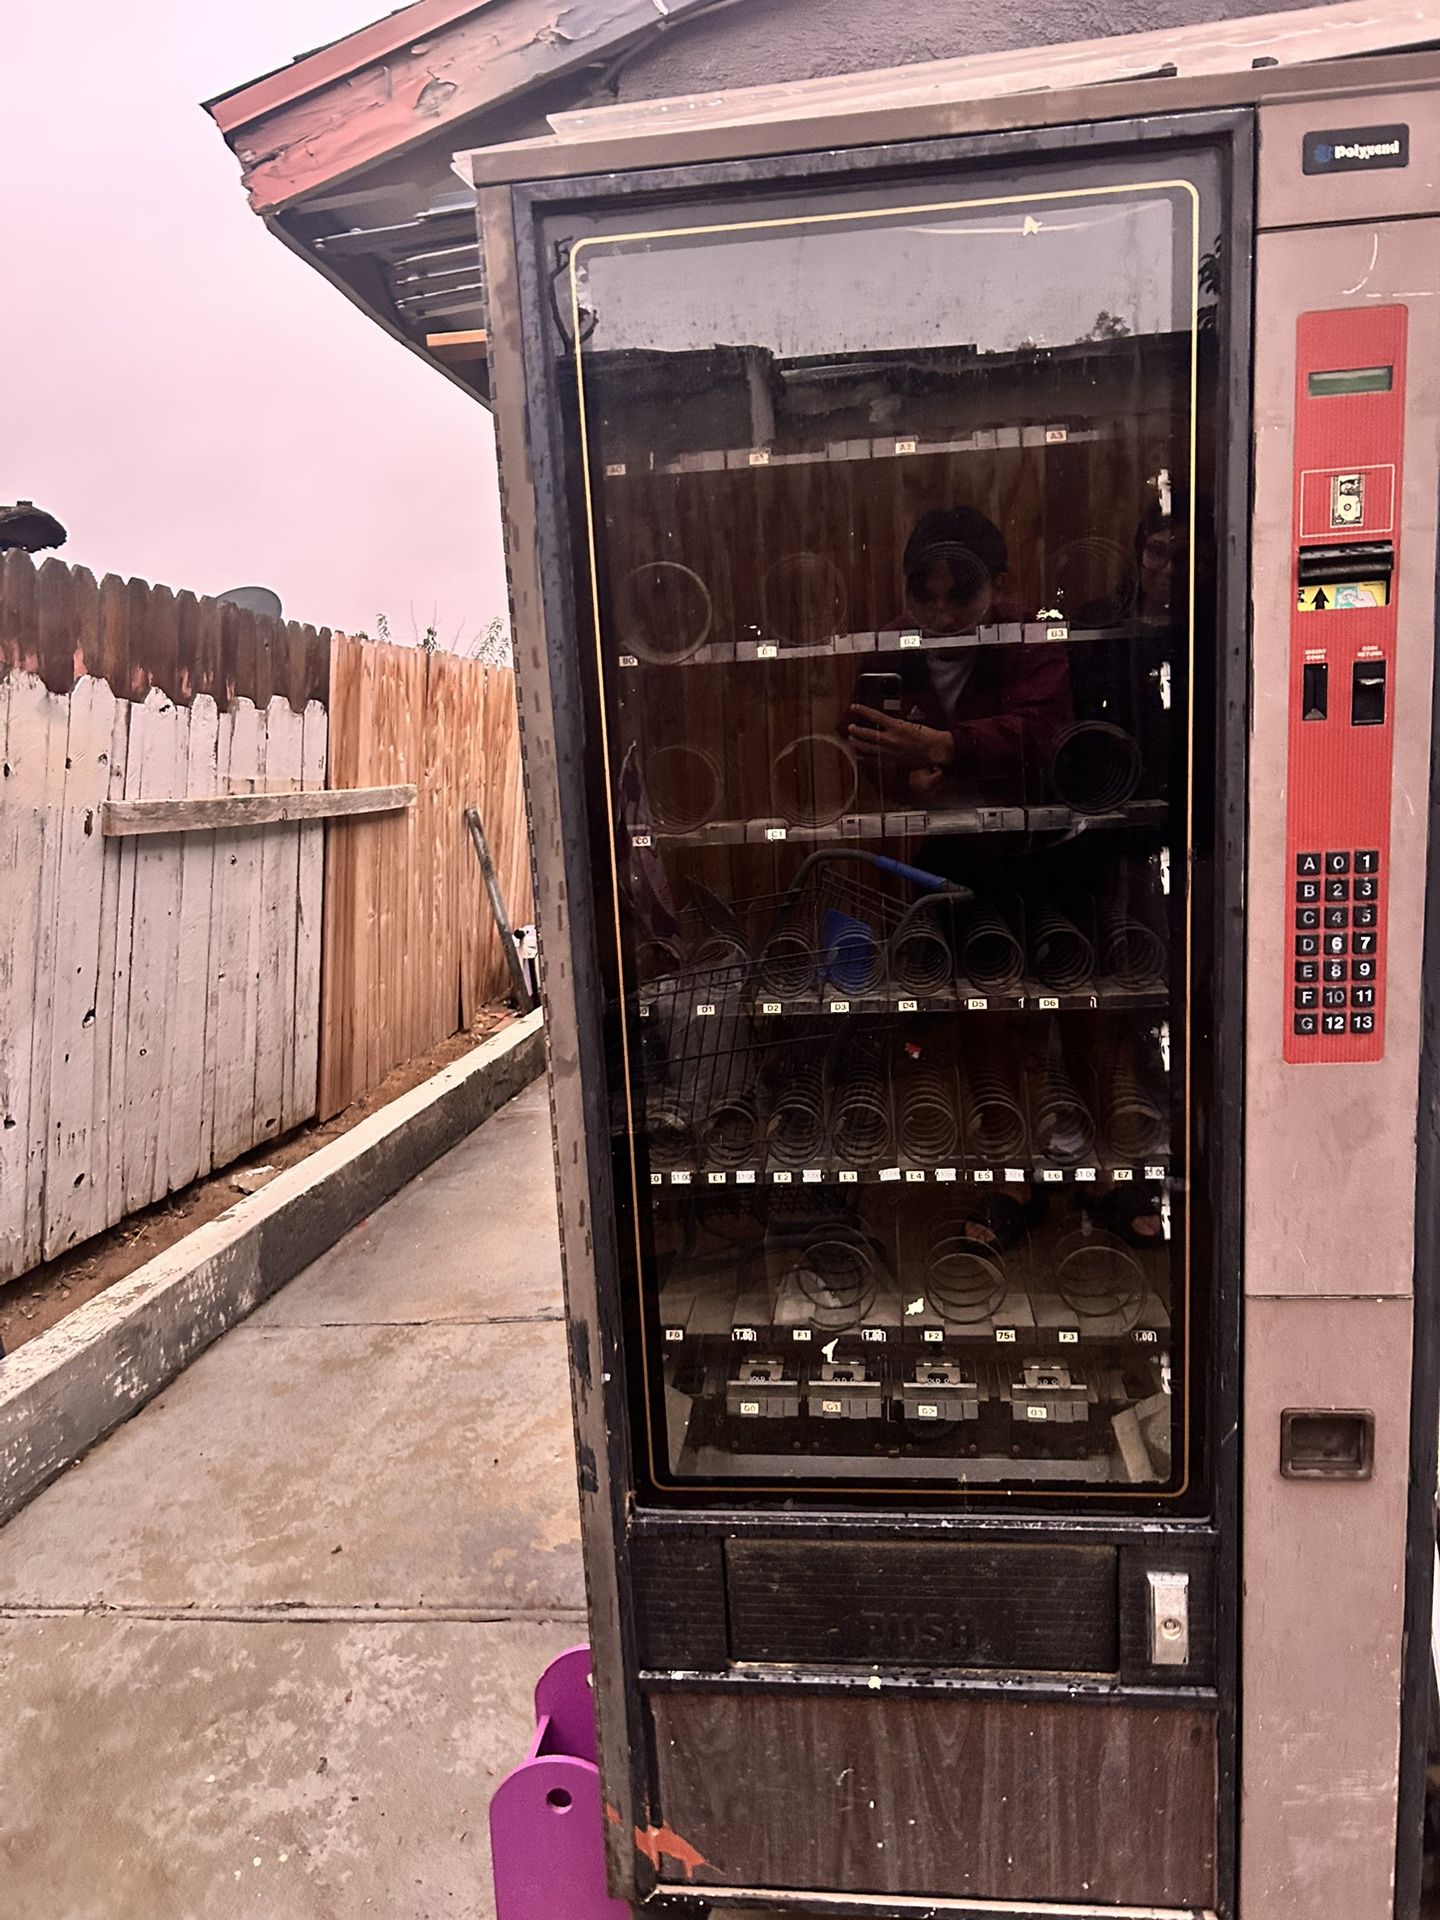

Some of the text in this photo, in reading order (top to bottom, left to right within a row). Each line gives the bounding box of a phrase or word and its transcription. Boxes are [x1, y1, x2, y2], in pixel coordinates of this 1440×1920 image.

[1334, 140, 1400, 159] Polyvend
[1303, 857, 1315, 871] A
[1362, 854, 1370, 868] 1
[1303, 883, 1372, 898] B 2 3
[1302, 909, 1371, 924] C 4 5
[1302, 936, 1371, 952] D 6 7
[1302, 962, 1370, 978] E 8 9
[1302, 989, 1372, 1004] F 10 11
[1301, 1016, 1373, 1030] G 12 13
